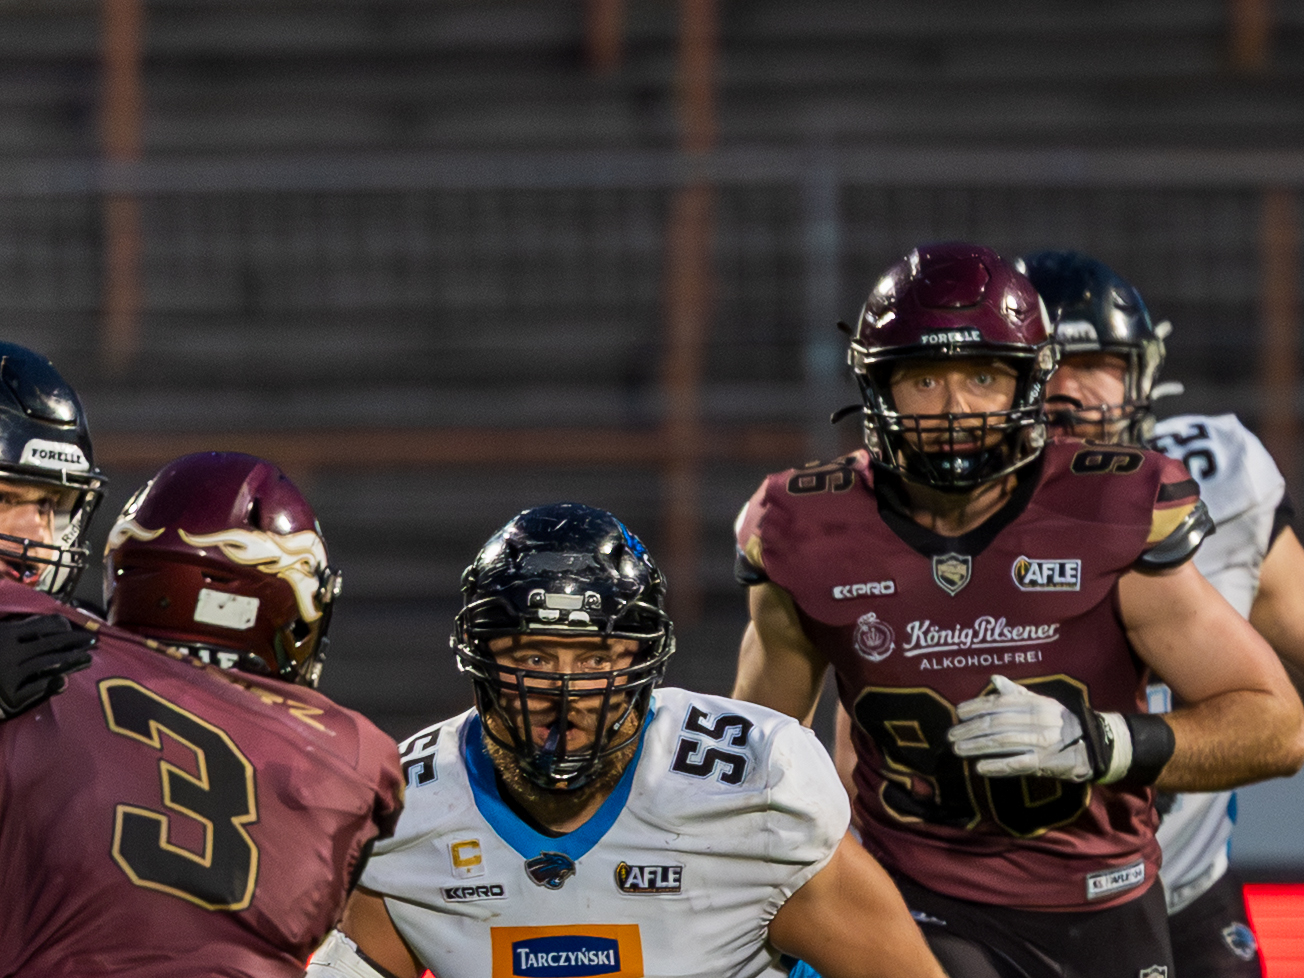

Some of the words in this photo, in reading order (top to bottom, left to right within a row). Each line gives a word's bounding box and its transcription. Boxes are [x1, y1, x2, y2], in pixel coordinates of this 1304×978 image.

[921, 331, 981, 344] FORELLE
[1023, 562, 1078, 584] AFLE
[919, 650, 1044, 671] ALKOHOLFREI
[669, 703, 755, 788] 55
[97, 676, 259, 911] 3
[451, 838, 482, 868] C
[624, 866, 683, 888] AFLE
